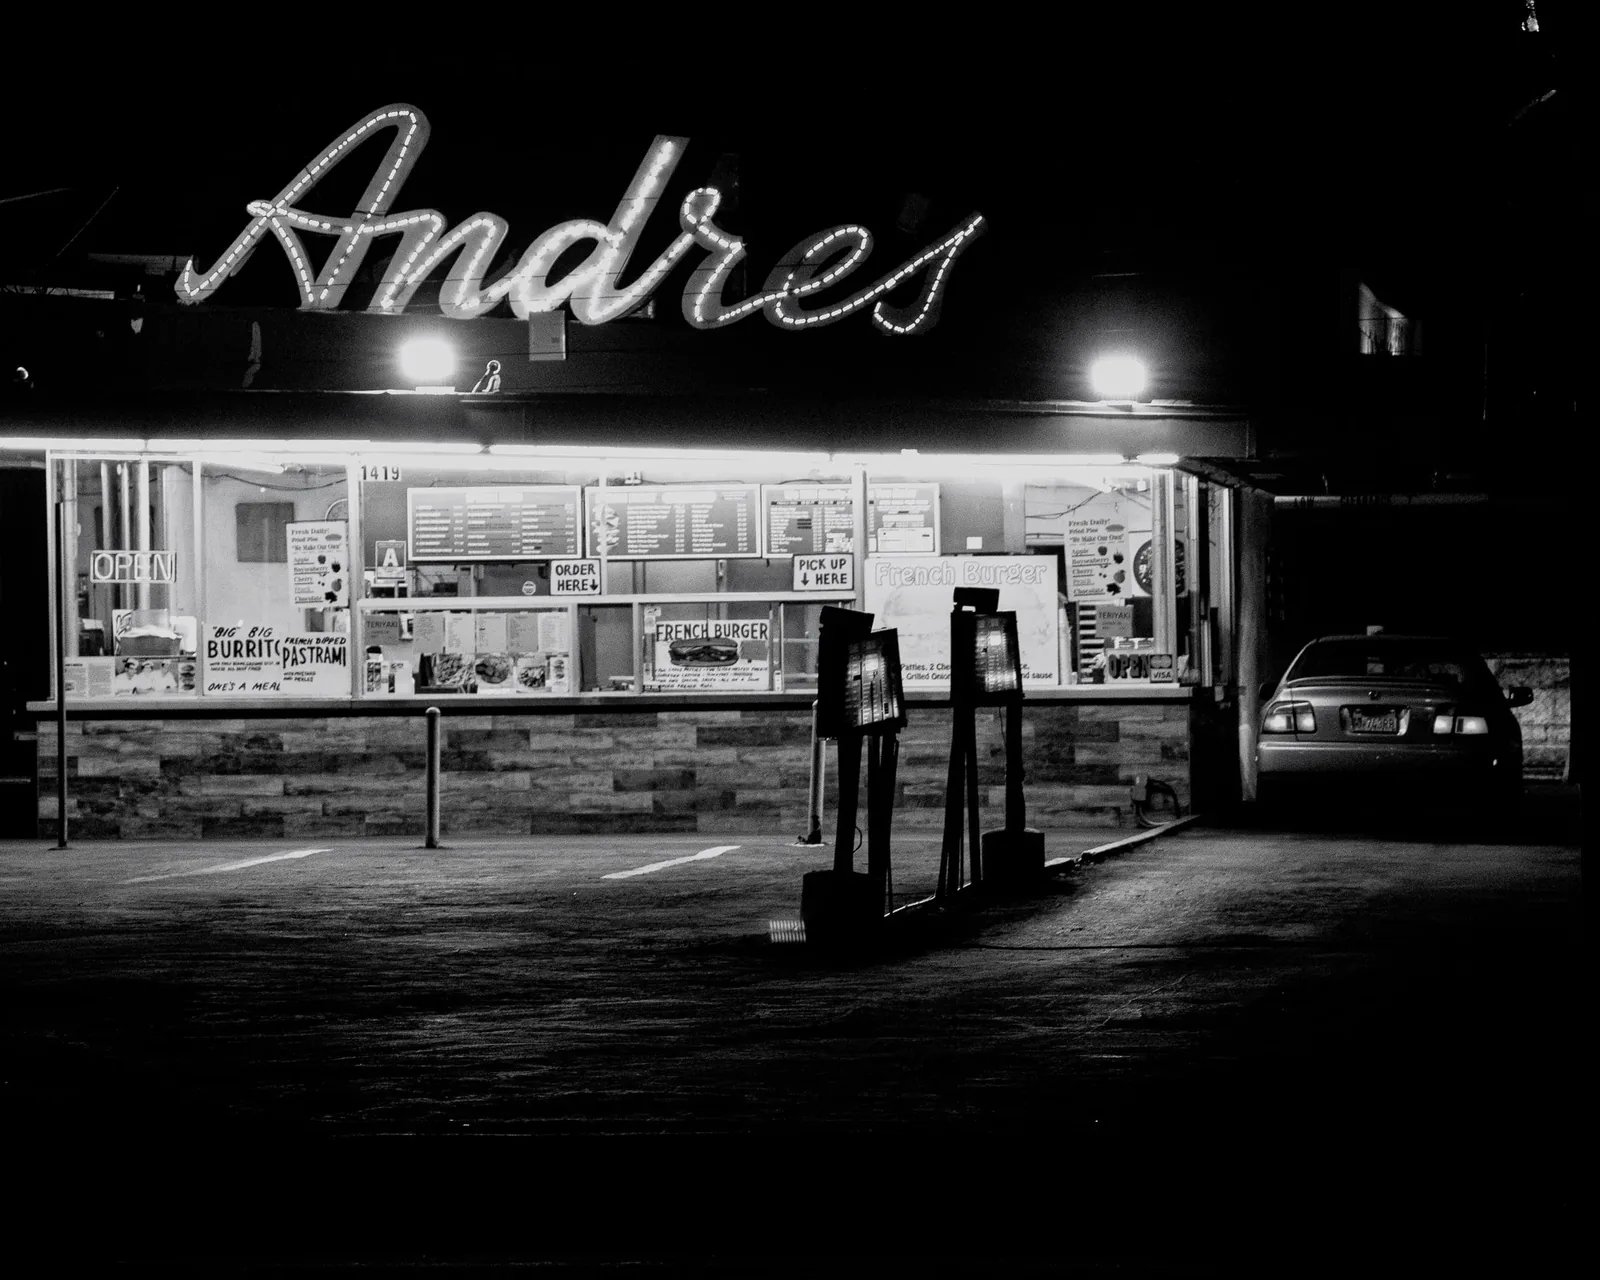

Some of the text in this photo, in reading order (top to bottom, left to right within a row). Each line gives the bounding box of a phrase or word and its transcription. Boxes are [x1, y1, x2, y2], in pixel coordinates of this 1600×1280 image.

[361, 465, 399, 480] 1419
[382, 548, 399, 567] A
[799, 558, 847, 570] PICK UP
[95, 553, 171, 580] OPEN
[556, 564, 596, 576] ORDER
[875, 560, 1047, 586] French Burger
[557, 579, 589, 591] HERE
[815, 573, 847, 585] HERE
[248, 627, 273, 638] BIG
[656, 623, 768, 641] FRENCH BURGER
[284, 636, 346, 645] FRENCH DIPPED
[283, 646, 346, 669] PASTRAMI
[1108, 654, 1150, 679] OPEN
[208, 681, 280, 691] ONE'S A MEAL
